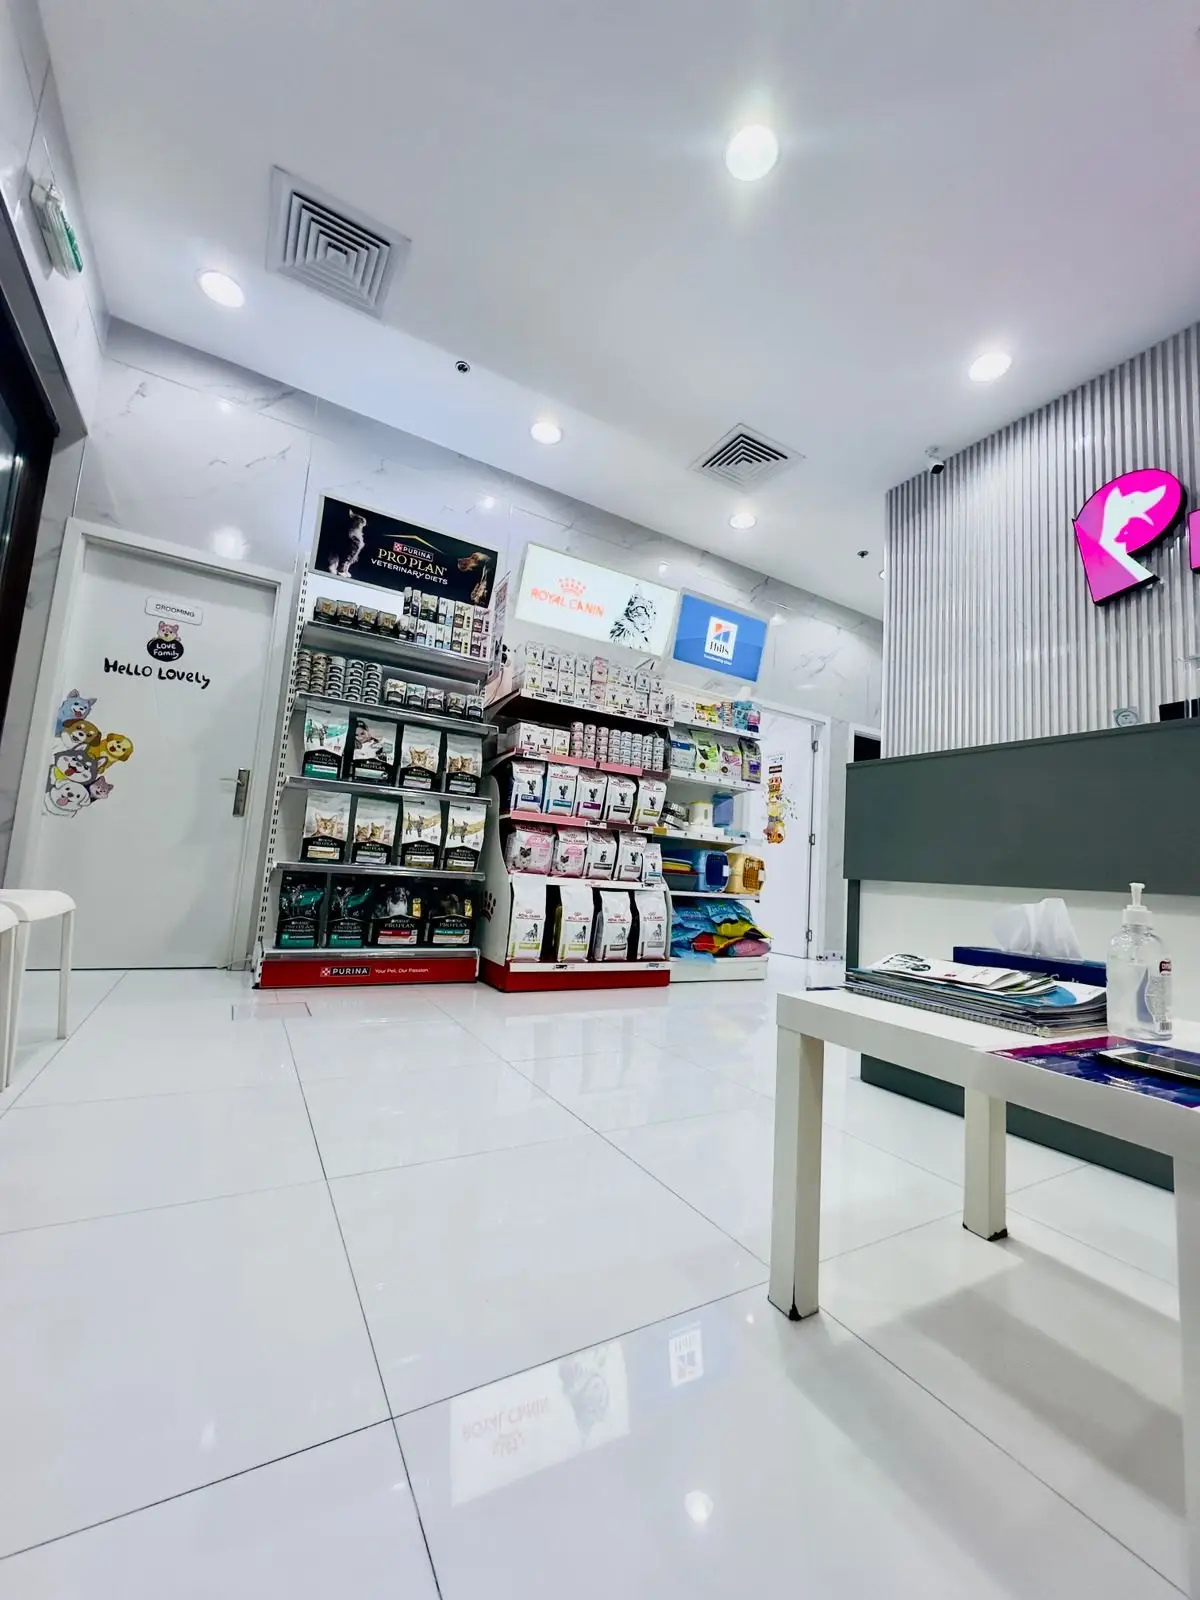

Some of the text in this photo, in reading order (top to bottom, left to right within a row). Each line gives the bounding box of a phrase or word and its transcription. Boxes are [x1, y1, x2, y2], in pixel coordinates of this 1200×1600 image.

[403, 546, 431, 560] PURINA
[377, 548, 446, 577] PRO PLAN
[370, 557, 448, 585] VETERINARY DIETS
[530, 587, 603, 617] ROYAL CANIN
[155, 603, 195, 618] GROOMING
[153, 648, 180, 660] Family
[332, 967, 369, 975] PURINA
